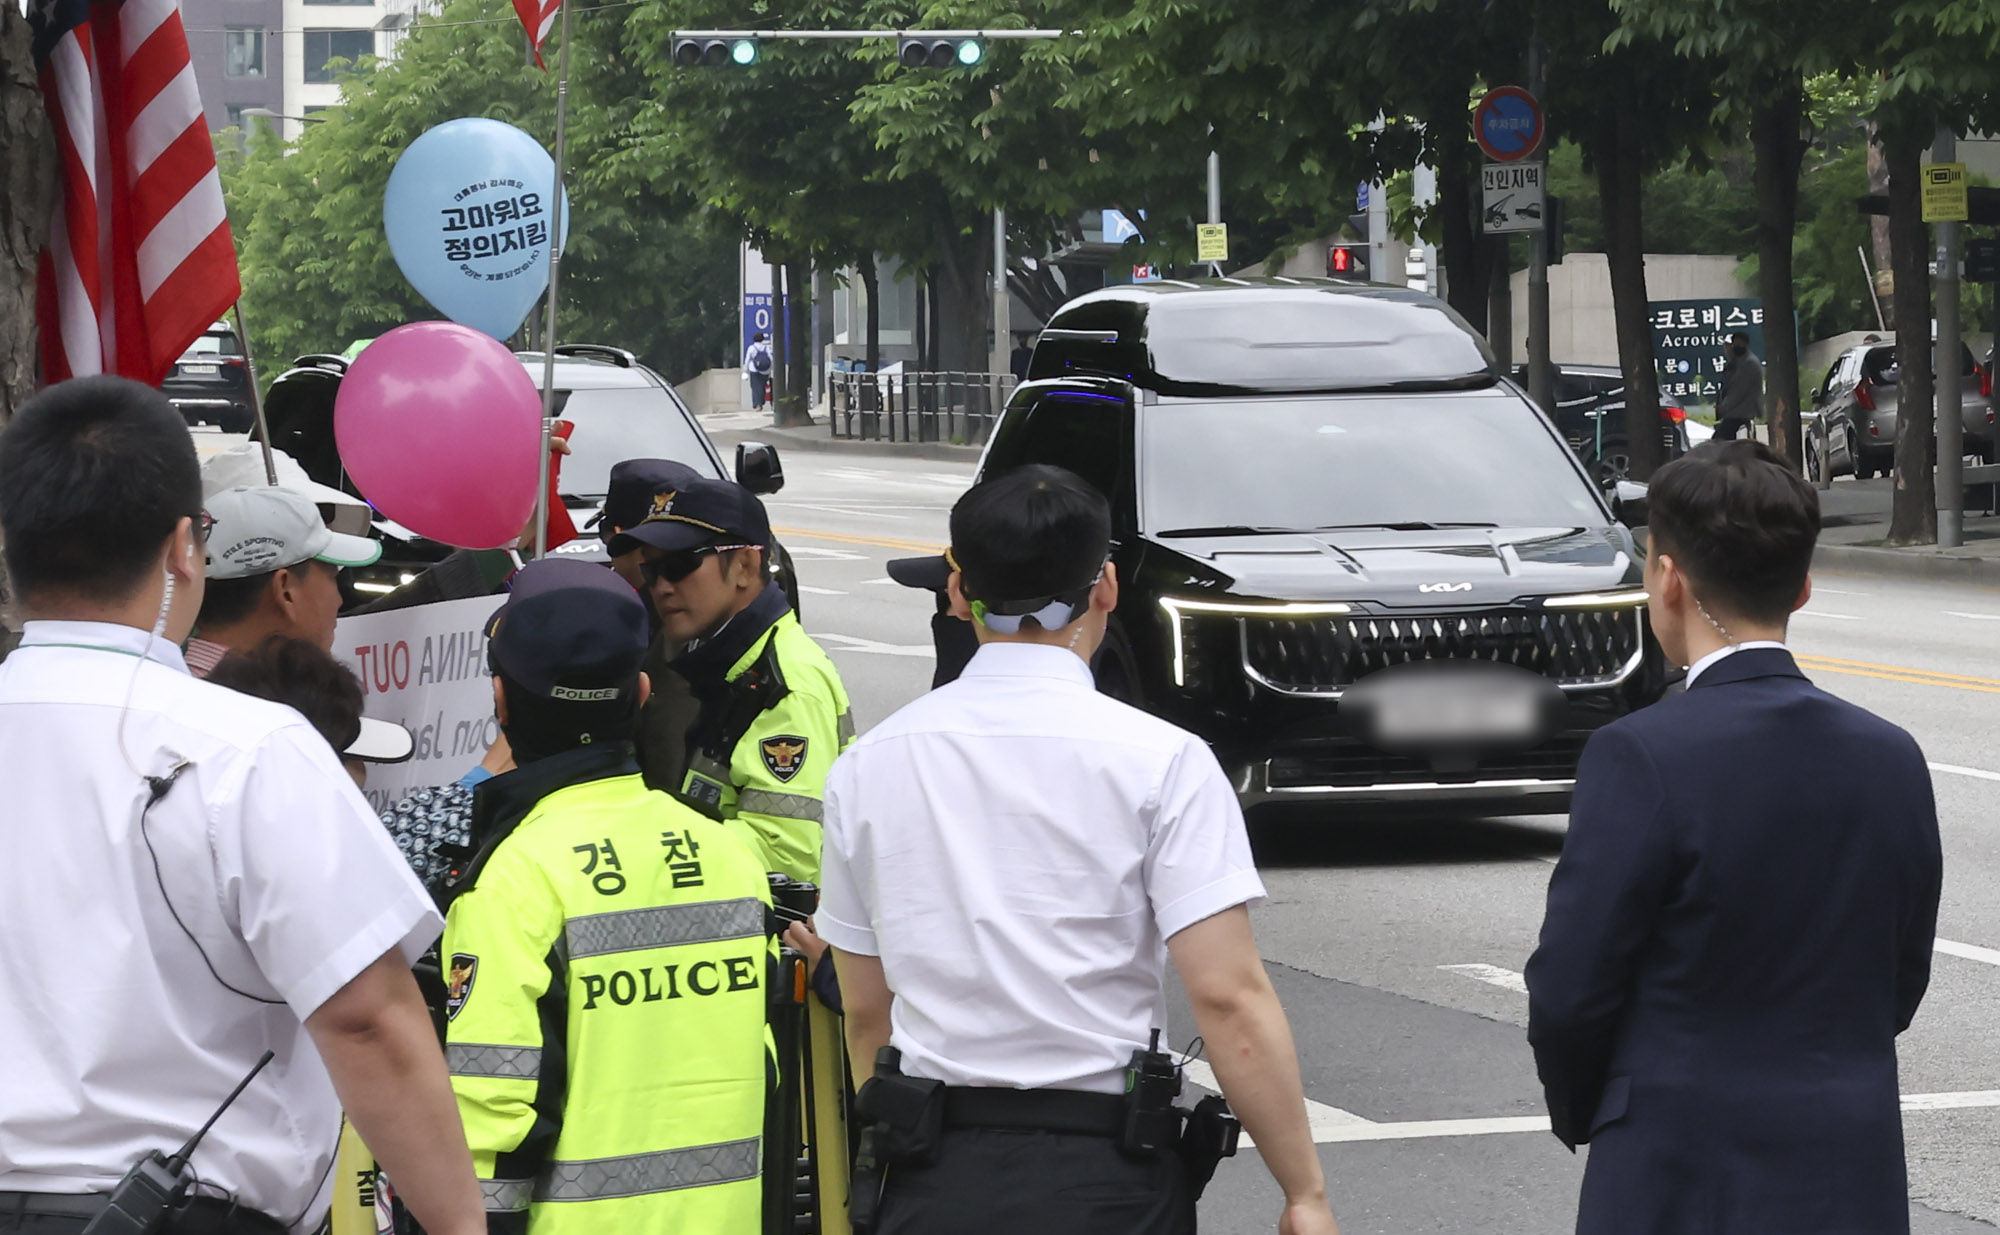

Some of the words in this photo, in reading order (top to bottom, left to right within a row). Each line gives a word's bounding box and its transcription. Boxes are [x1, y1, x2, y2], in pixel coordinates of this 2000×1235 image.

[441, 192, 543, 232] 고마워요
[444, 220, 547, 261] 정의지킴
[555, 687, 614, 699] POLICE
[578, 956, 760, 1010] POLICE
